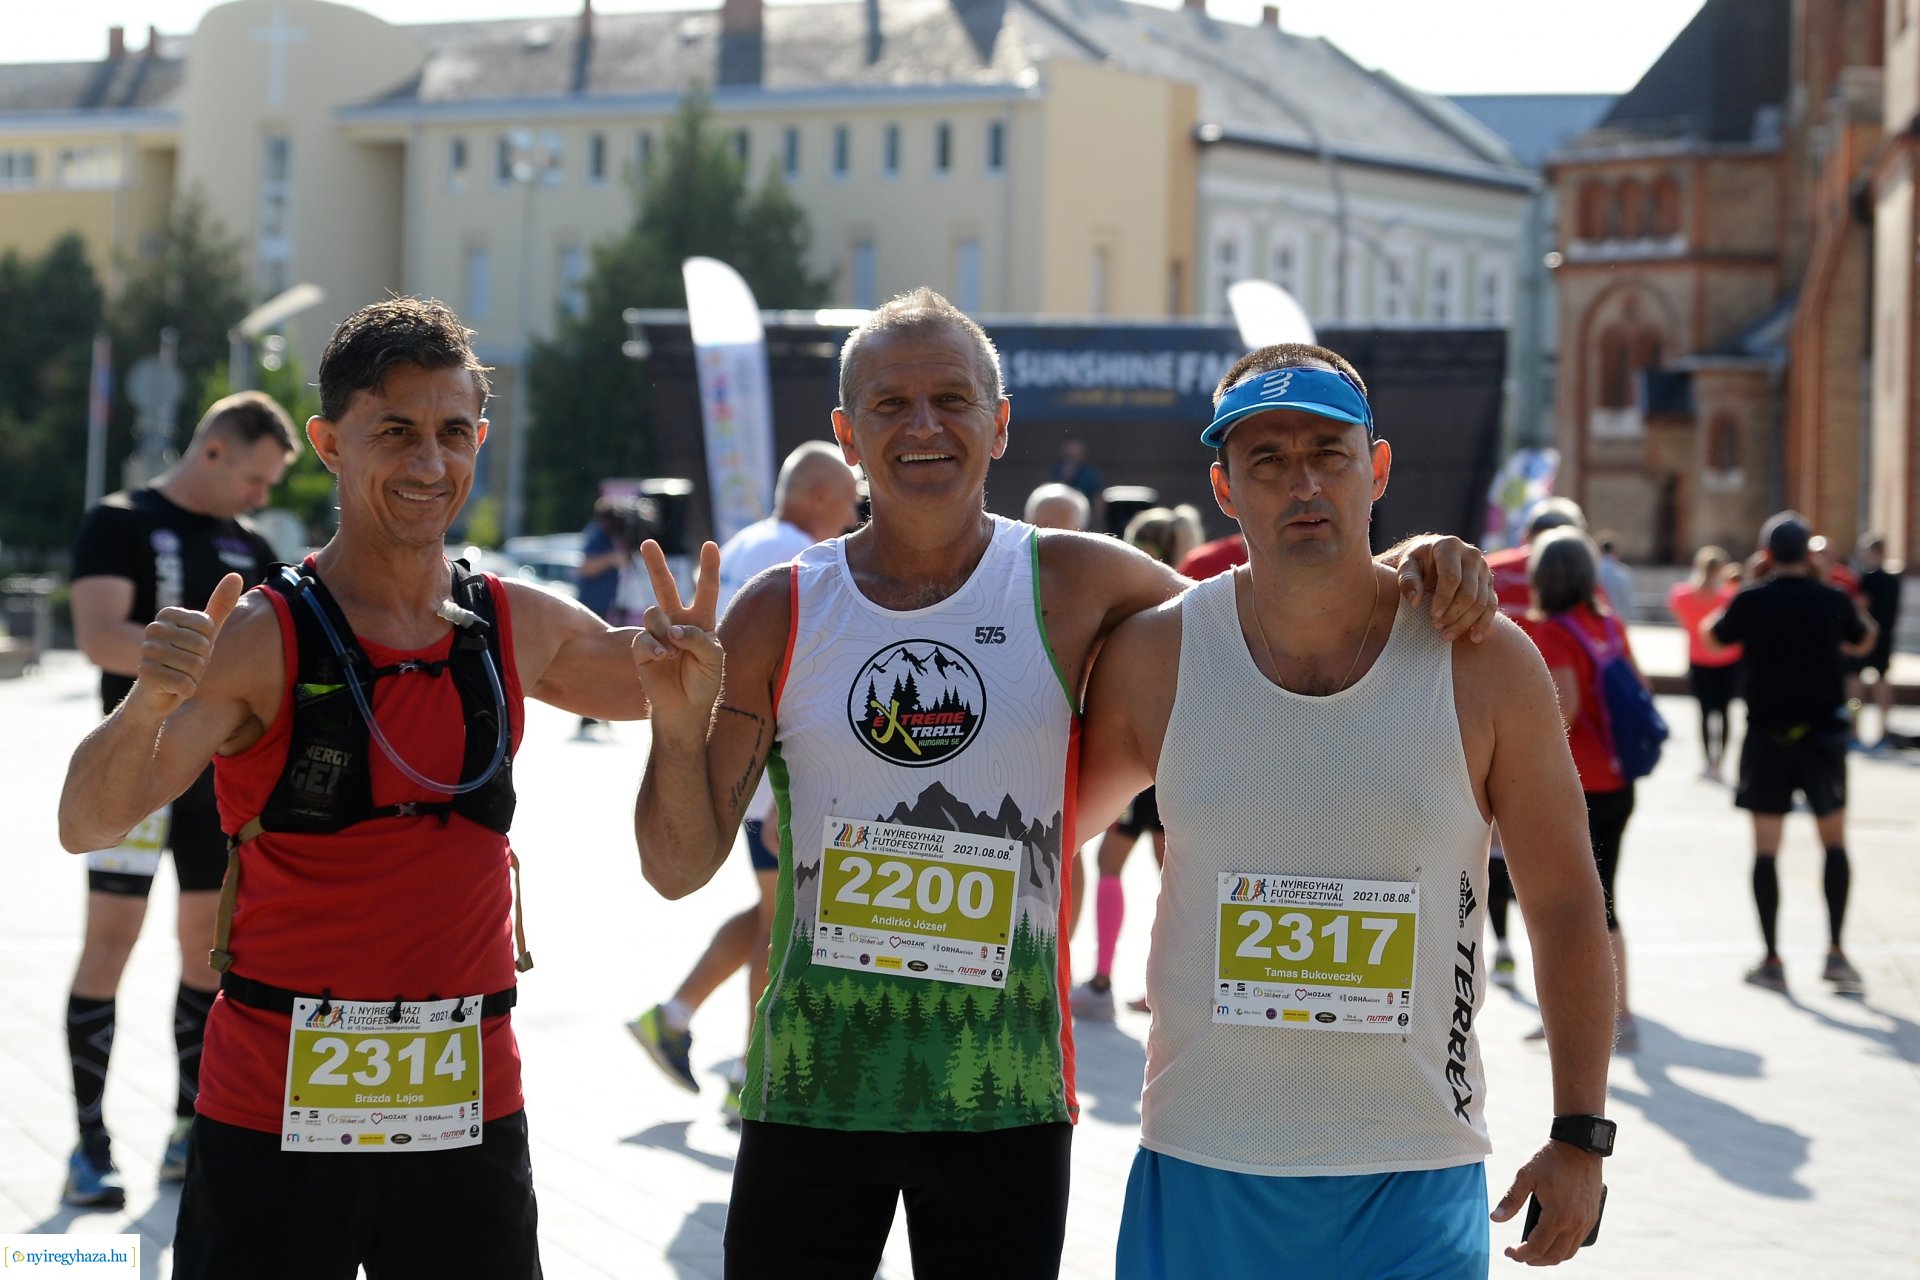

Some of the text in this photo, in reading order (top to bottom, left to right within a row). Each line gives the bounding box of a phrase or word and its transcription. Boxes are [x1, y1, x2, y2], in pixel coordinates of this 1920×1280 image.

[975, 626, 1006, 645] 575
[911, 725, 965, 738] TRAIL
[918, 738, 949, 747] HUNGARY
[302, 743, 353, 768] NERGY
[883, 828, 945, 844] NYÍREGYHÁZI
[872, 837, 945, 854] FUTÓFESZTIVÁL
[953, 844, 1012, 861] 2021.08.08.
[835, 856, 995, 920] 2200
[1272, 879, 1344, 892] I. NYÍREGYHÁZI
[1270, 888, 1344, 902] FUTÓFESZTIVÁL
[1352, 891, 1412, 904] 2021.08.08.
[1459, 870, 1467, 929] adidas
[913, 919, 948, 933] József
[901, 939, 925, 948] MOZAIK
[1235, 910, 1398, 966] 2317
[1265, 967, 1363, 984] Tamas Bukoveczky
[358, 1005, 421, 1015] NYÍREGHÁZI
[348, 1014, 421, 1025] FUTÓFESIVÁL
[1445, 939, 1477, 1126] TERREX
[308, 1033, 467, 1087] 2314
[355, 1093, 424, 1104] Brázda Lajos
